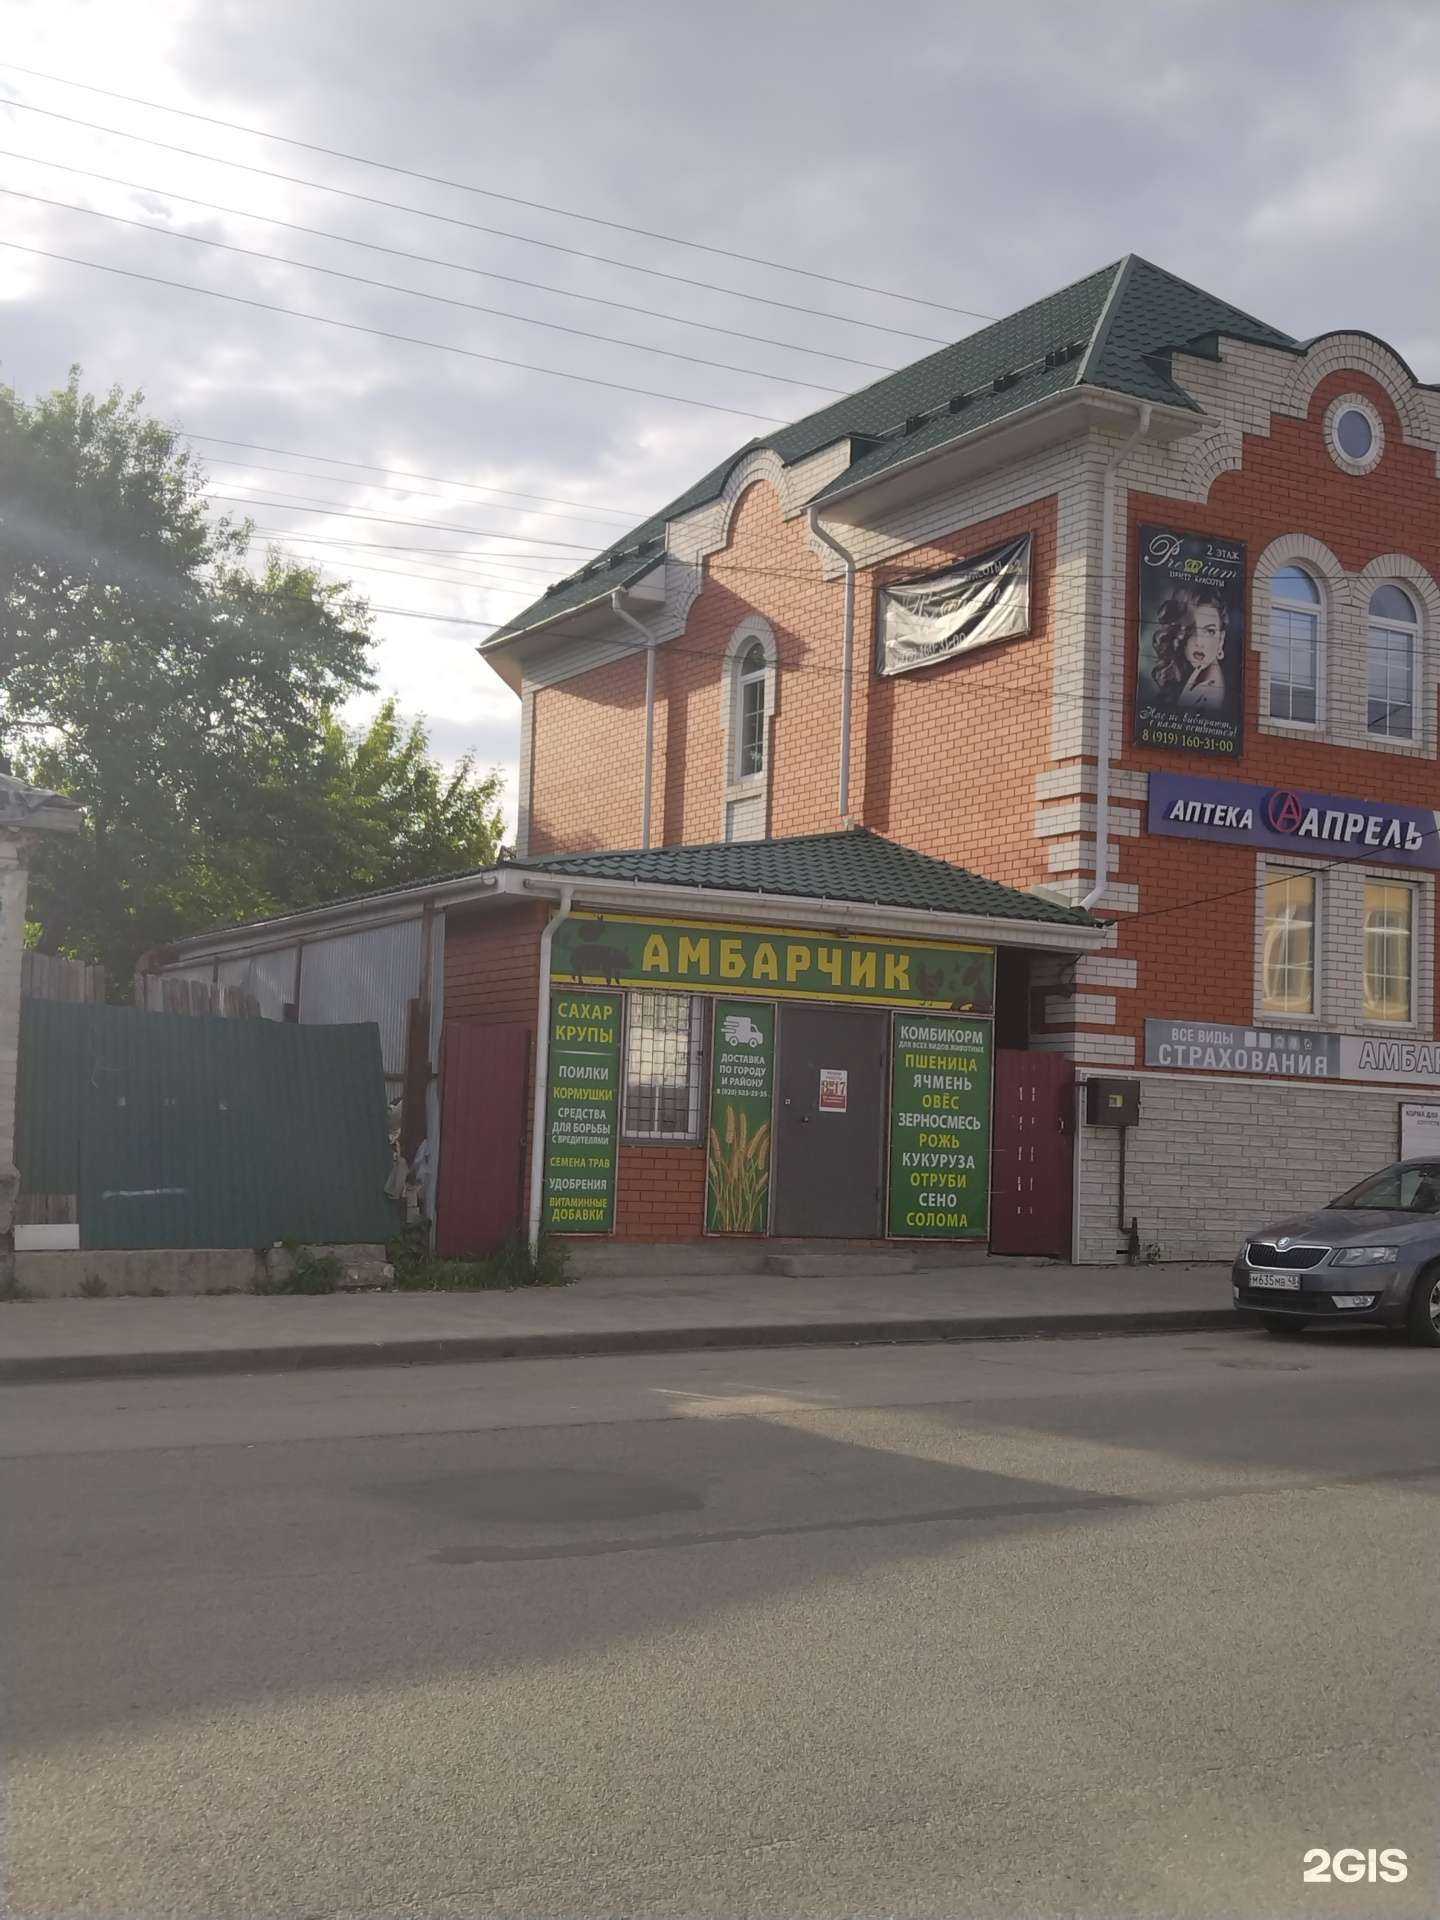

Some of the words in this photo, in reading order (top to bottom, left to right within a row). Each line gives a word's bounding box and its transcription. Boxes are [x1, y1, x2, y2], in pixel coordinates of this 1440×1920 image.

[1206, 545, 1213, 556] 2
[1142, 729, 1149, 741] 8
[1153, 731, 1178, 745] (919)
[1182, 735, 1233, 752] 160-31-00
[1169, 799, 1254, 830] АПТЕКА
[1299, 808, 1423, 851] АПРЕЛЬ
[642, 933, 910, 991] АМБАРЧИК
[558, 1003, 613, 1020] САХАР
[556, 1025, 613, 1043] КРУПЫ
[900, 1026, 983, 1044] КОМБИКОРМ
[1171, 1027, 1194, 1042] ВСЕ
[1198, 1029, 1233, 1044] ВИДЫ
[721, 1053, 765, 1064] ДОСТАВКА
[905, 1054, 977, 1073] ПШЕНИЦА
[1158, 1043, 1328, 1075] СТРАХОВАНИЯ
[559, 1065, 609, 1080] ПОИЛКИ
[720, 1065, 732, 1074] ПО
[733, 1066, 766, 1077] ГОРОДУ
[722, 1077, 728, 1085] И
[730, 1077, 763, 1087] РАЙОНУ
[913, 1074, 972, 1091] ЯЧМЕНЬ
[553, 1087, 613, 1101] КОРМУШКИ
[922, 1092, 960, 1109] ОВЁС
[558, 1107, 606, 1120] СРЕДСТВА
[552, 1122, 571, 1134] ДЛЯ
[573, 1123, 610, 1134] БОРЬБЫ
[898, 1113, 981, 1131] ЗЕРНОСМЕСЬ
[919, 1133, 960, 1149] РОЖЬ
[550, 1157, 586, 1168] СЕМЕНА
[588, 1159, 610, 1168] ТРАВ
[902, 1152, 975, 1169] КУКУРУЗА
[549, 1178, 607, 1191] УДОБРЕНИЯ
[910, 1172, 967, 1188] ОТРУБИ
[549, 1197, 607, 1208] ВИТАМИННЫЕ
[919, 1193, 957, 1208] СЕНО
[552, 1208, 603, 1221] ДОБАВКИ
[906, 1212, 968, 1227] СОЛОМА
